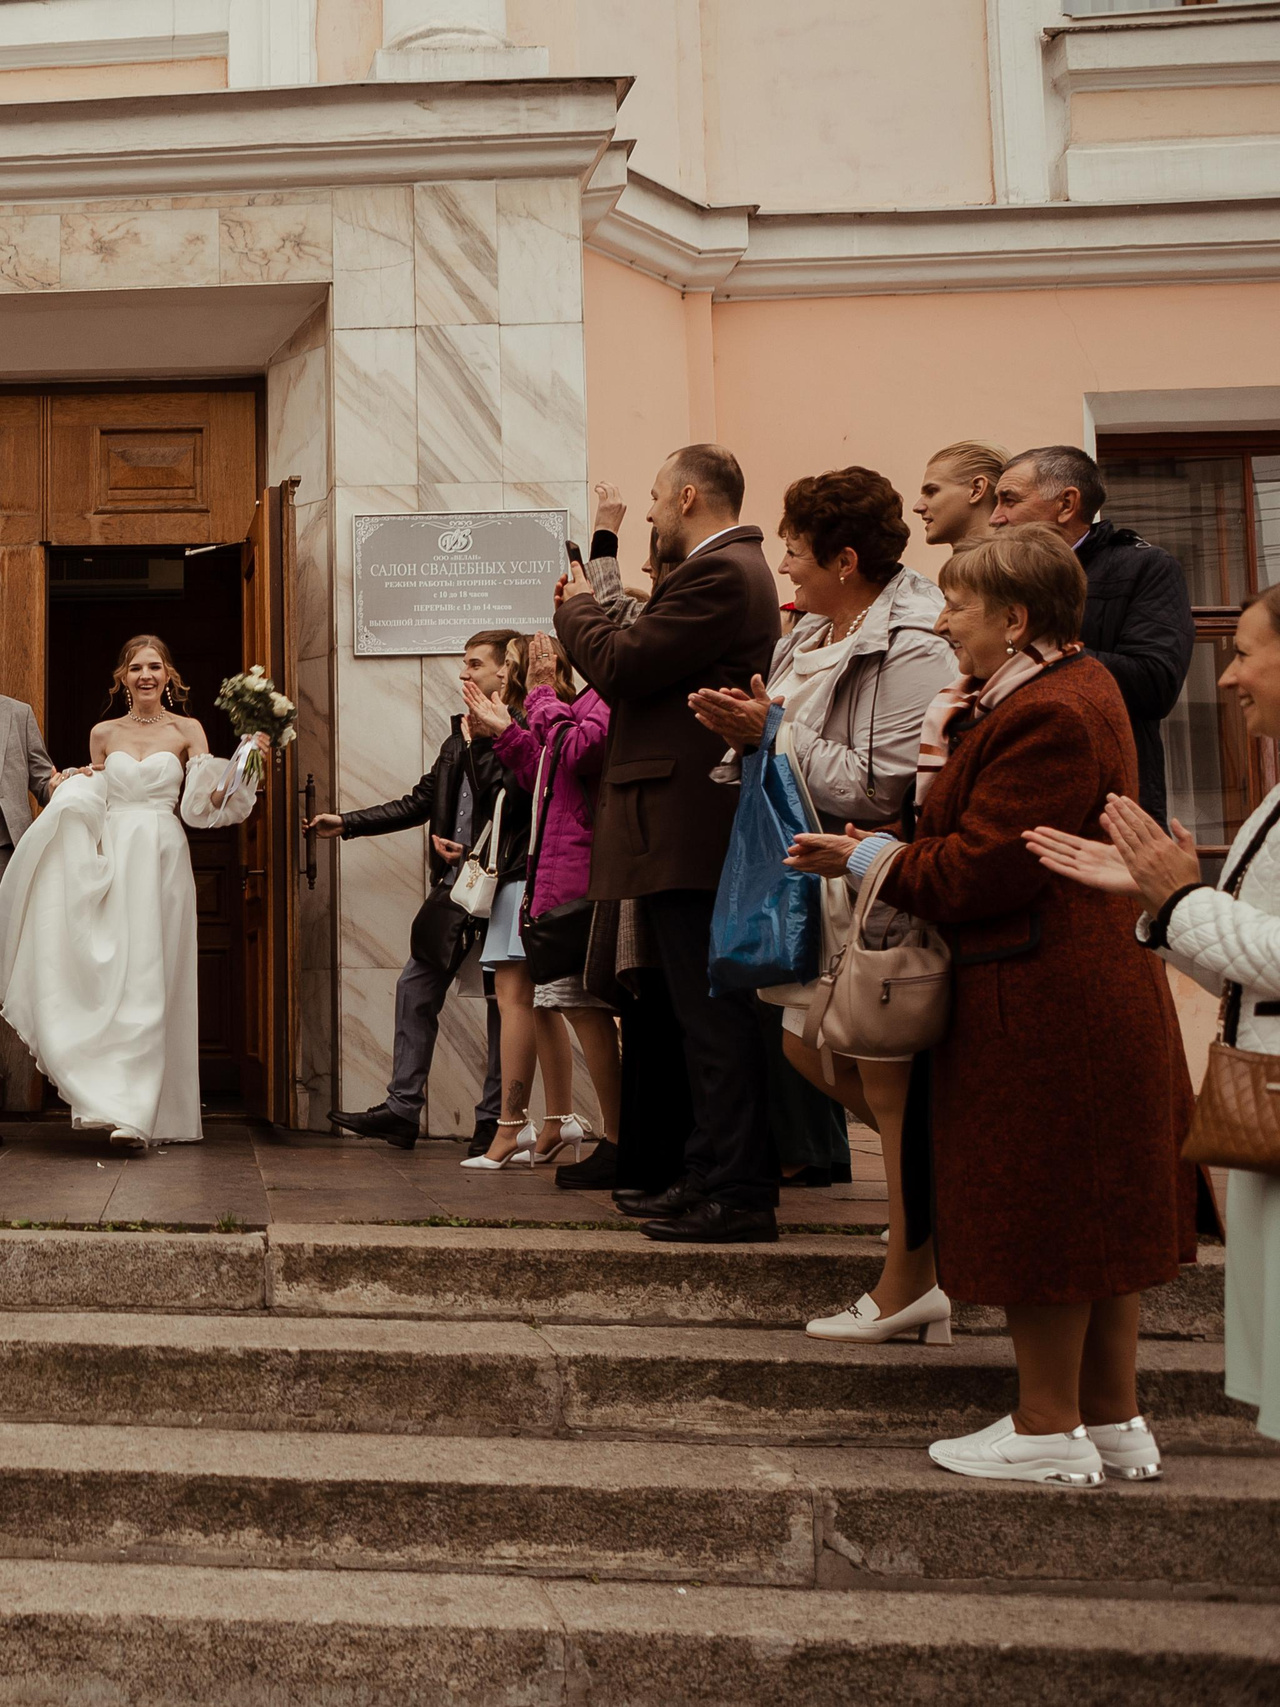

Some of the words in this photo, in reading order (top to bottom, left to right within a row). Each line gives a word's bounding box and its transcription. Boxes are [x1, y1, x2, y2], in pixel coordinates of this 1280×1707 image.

[370, 563, 417, 577] САЛОН
[420, 561, 506, 578] СВАДЕБНЫХ
[510, 560, 554, 574] УСЛУГ
[384, 580, 417, 588] РЕЖИМ
[419, 579, 455, 588] РАБОТЫ:
[456, 579, 497, 587] ВТОРНИК
[503, 578, 542, 586] СУББОТА
[459, 590, 468, 598] 18
[413, 603, 456, 612] ПЕРЕРЫВ:
[462, 603, 471, 611] 13
[369, 618, 413, 627] ВЫХОДНОЙ
[414, 619, 437, 627] ДЕНЬ:
[438, 617, 494, 626] ВОСКРЕСЕНЬЕ,
